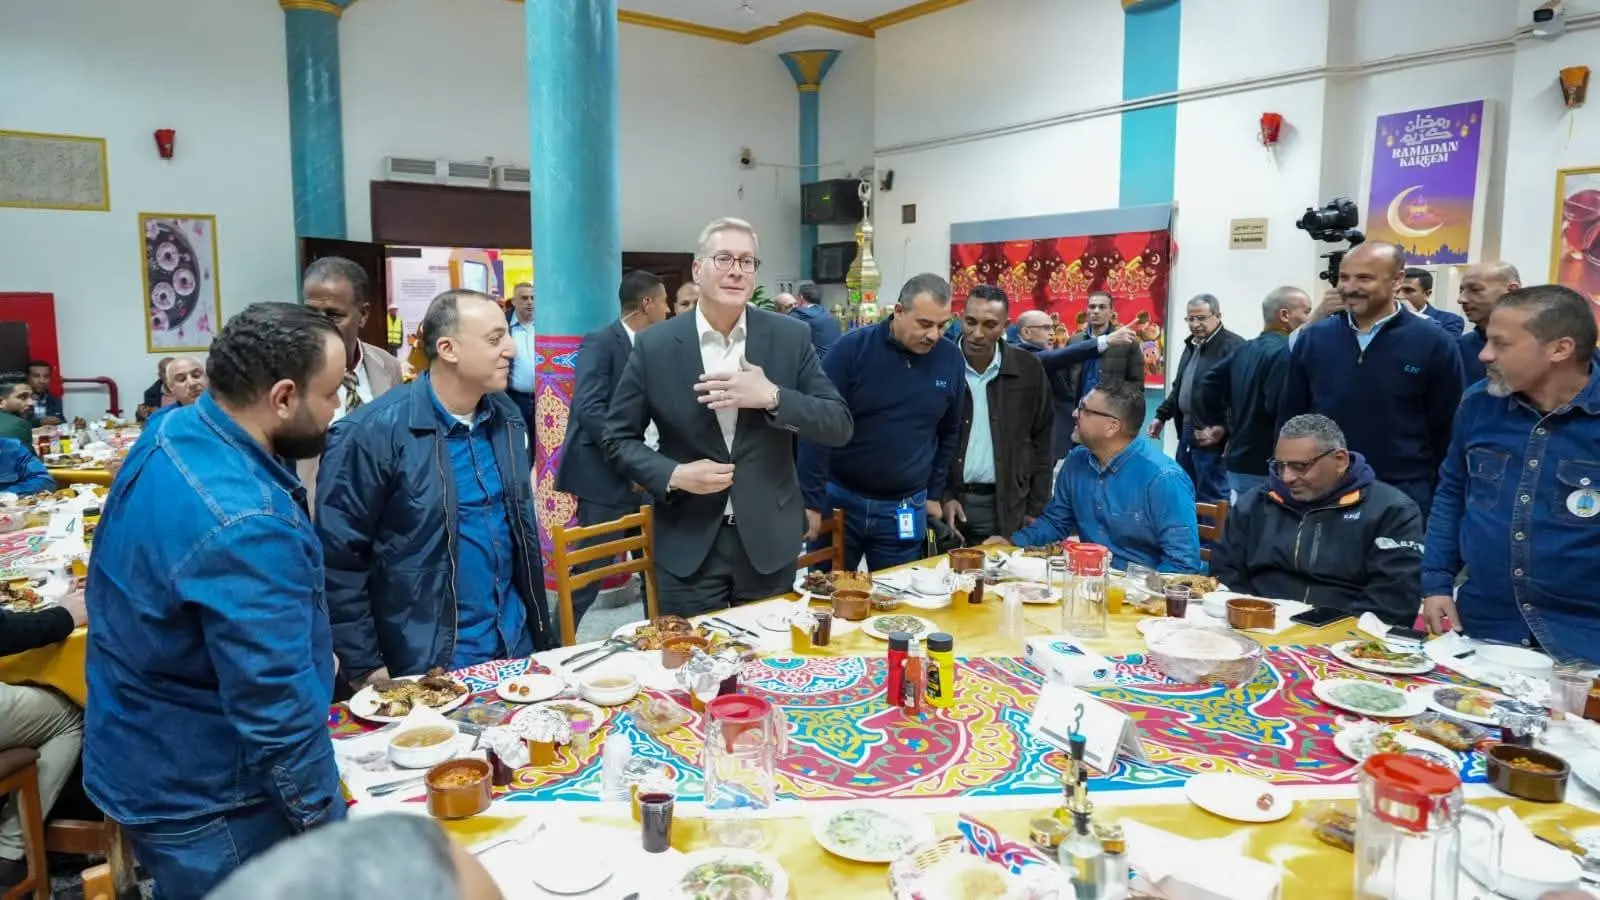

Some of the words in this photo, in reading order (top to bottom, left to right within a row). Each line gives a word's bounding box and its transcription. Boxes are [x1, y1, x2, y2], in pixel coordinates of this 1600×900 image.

[1391, 141, 1459, 158] RAMADAN
[1399, 152, 1449, 168] KAREEM
[1067, 703, 1085, 739] 3
